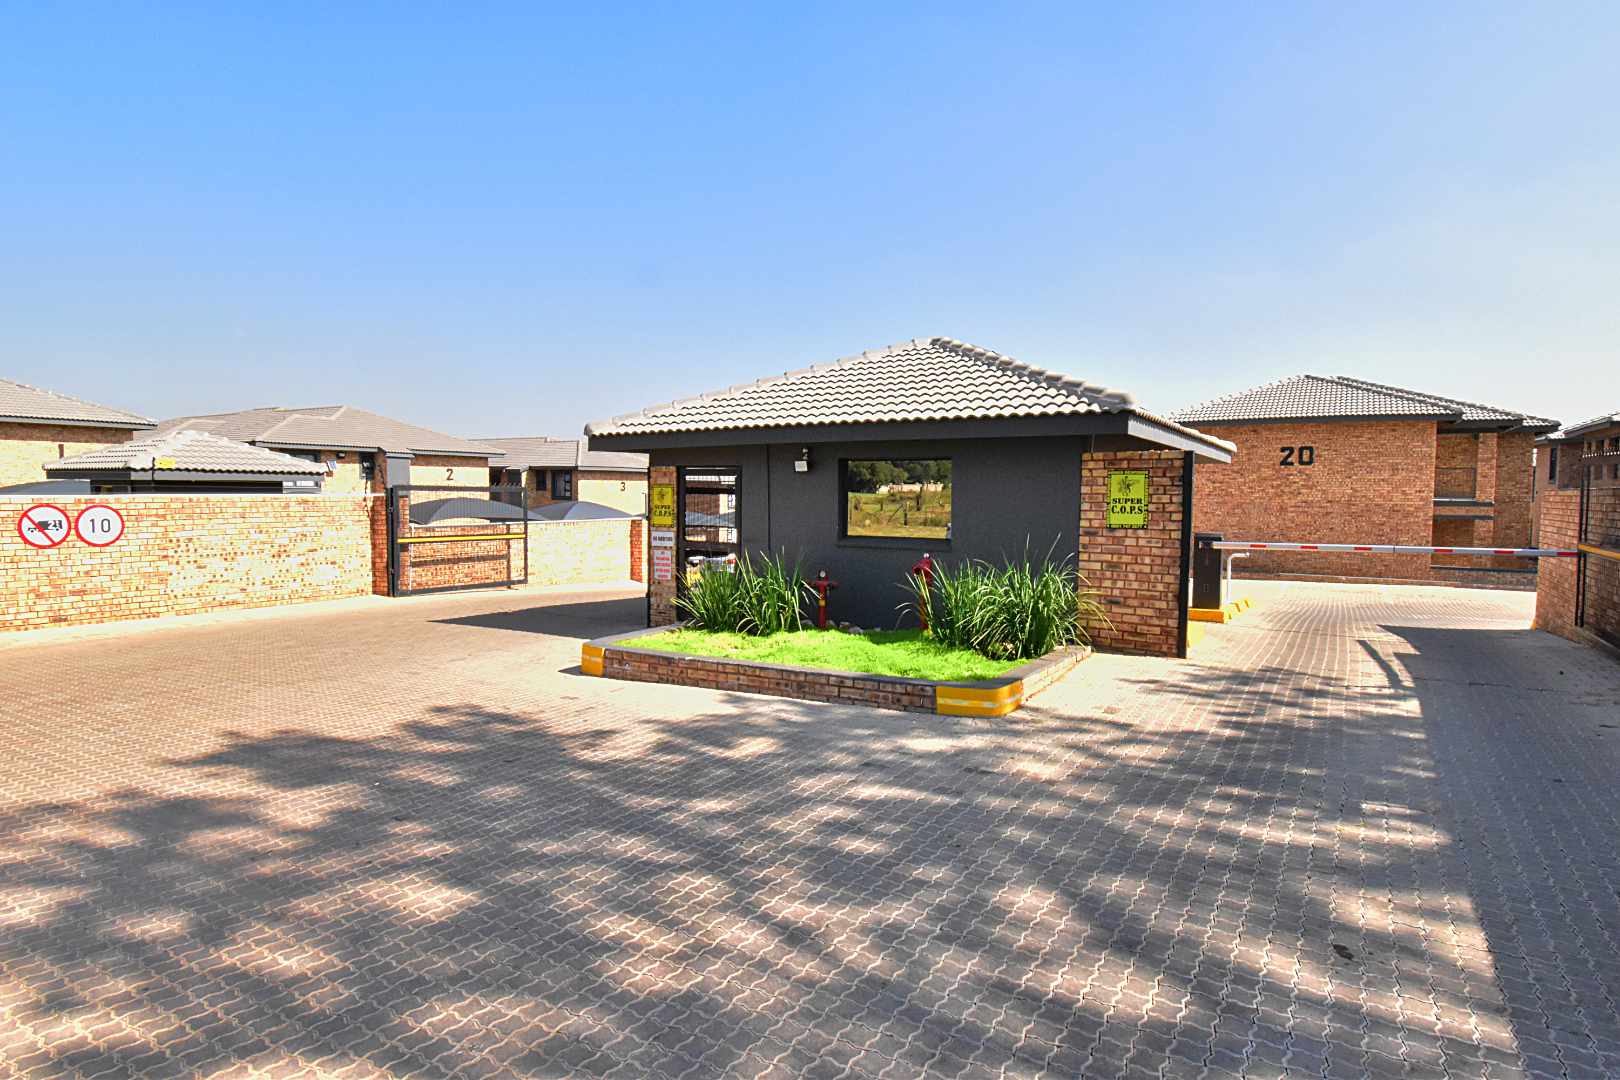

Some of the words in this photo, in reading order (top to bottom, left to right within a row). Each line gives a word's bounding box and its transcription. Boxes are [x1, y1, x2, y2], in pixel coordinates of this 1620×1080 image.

[1279, 446, 1314, 467] 20
[446, 468, 454, 481] 2
[620, 481, 626, 492] 3
[1111, 497, 1144, 505] SUPER
[89, 518, 111, 534] 10
